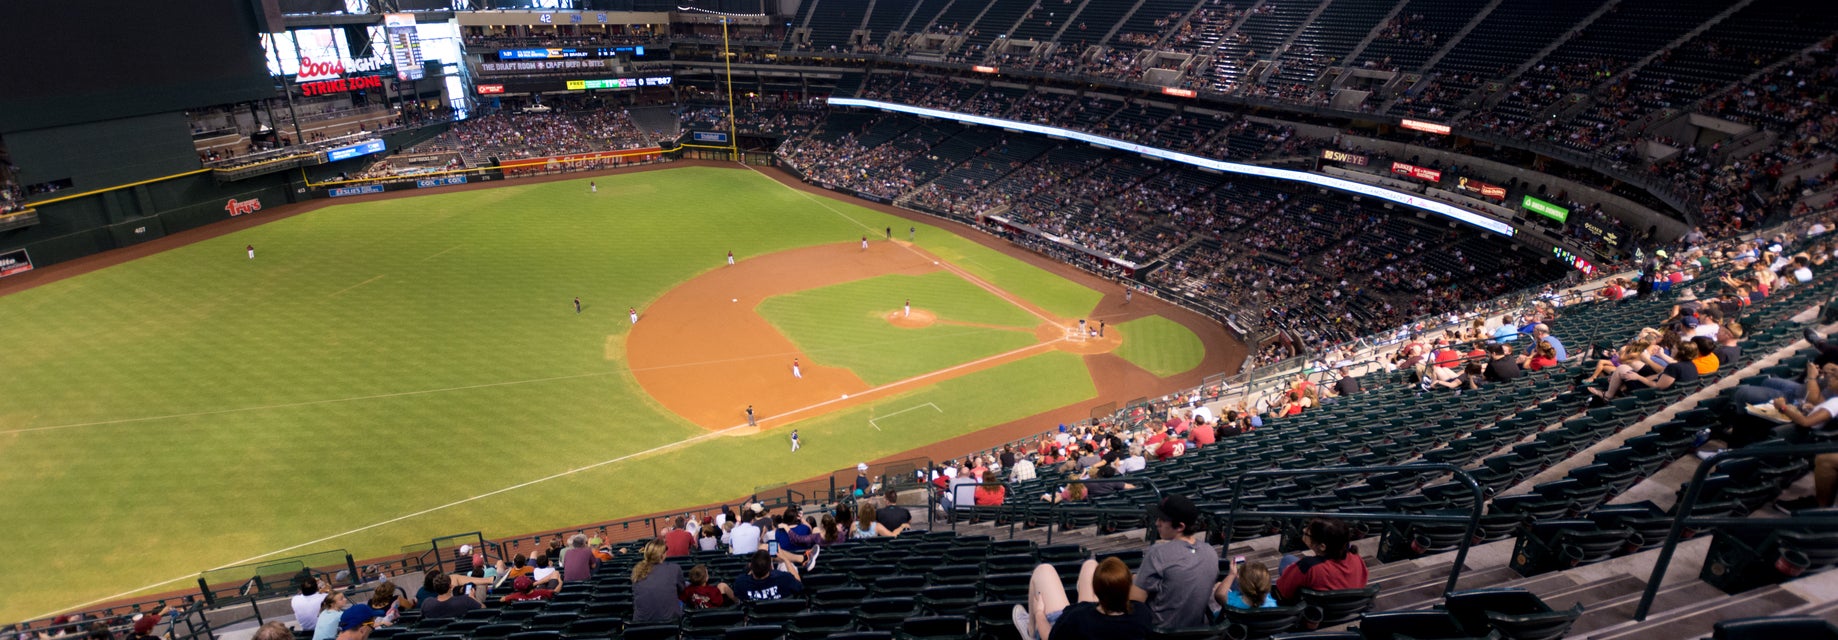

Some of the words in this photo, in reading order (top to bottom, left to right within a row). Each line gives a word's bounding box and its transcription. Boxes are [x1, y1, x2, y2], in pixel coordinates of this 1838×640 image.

[539, 13, 552, 23] 42
[298, 56, 345, 78] Coors
[345, 57, 381, 74] LIGHT
[482, 63, 495, 71] THE
[496, 62, 517, 71] DRAFT
[518, 62, 536, 70] ROOM
[301, 79, 348, 97] STRIKE
[348, 75, 383, 91] ZONE
[594, 154, 622, 166] Farm
[1172, 442, 1185, 457] 20
